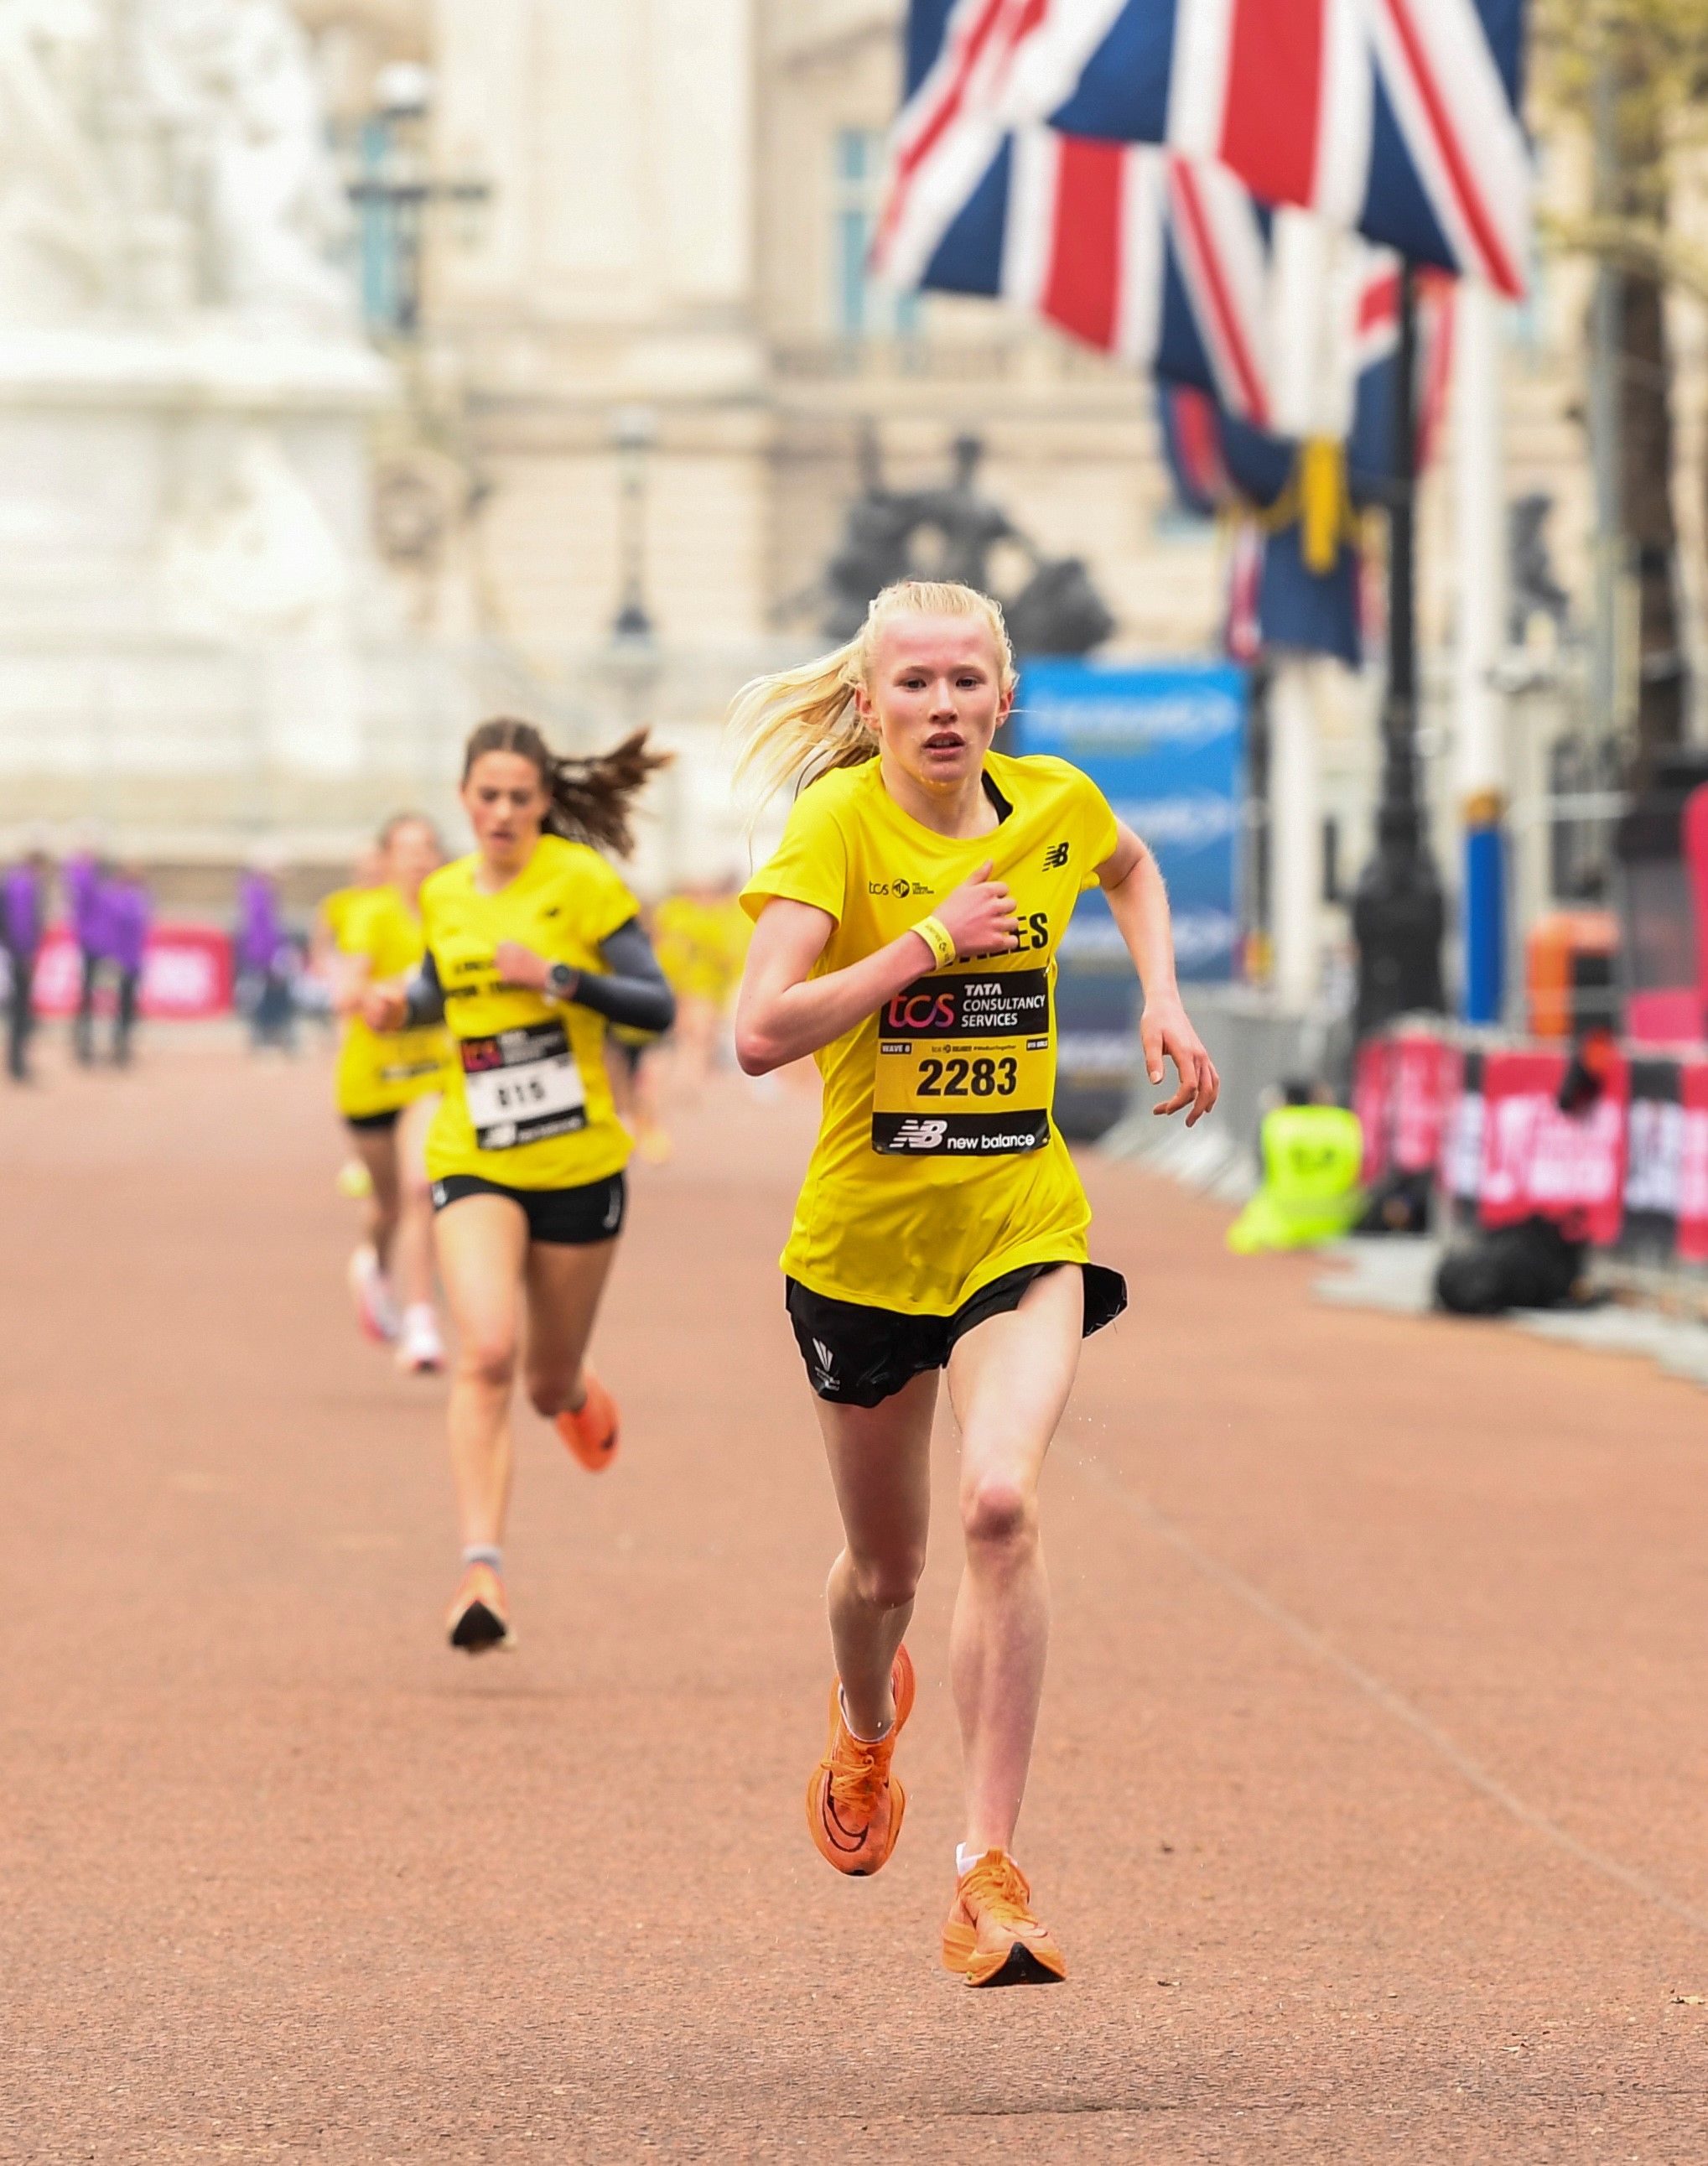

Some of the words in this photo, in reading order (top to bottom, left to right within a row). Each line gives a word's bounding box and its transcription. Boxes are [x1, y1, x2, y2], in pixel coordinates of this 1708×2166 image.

[869, 880, 889, 896] tcs
[964, 983, 1002, 997] TATA
[889, 993, 955, 1028] tcs
[963, 994, 1046, 1012] CONSULTANCY
[961, 1013, 1018, 1028] SERVICES
[916, 1057, 1018, 1097] 2283
[947, 1136, 979, 1150] new
[981, 1133, 1036, 1150] balance
